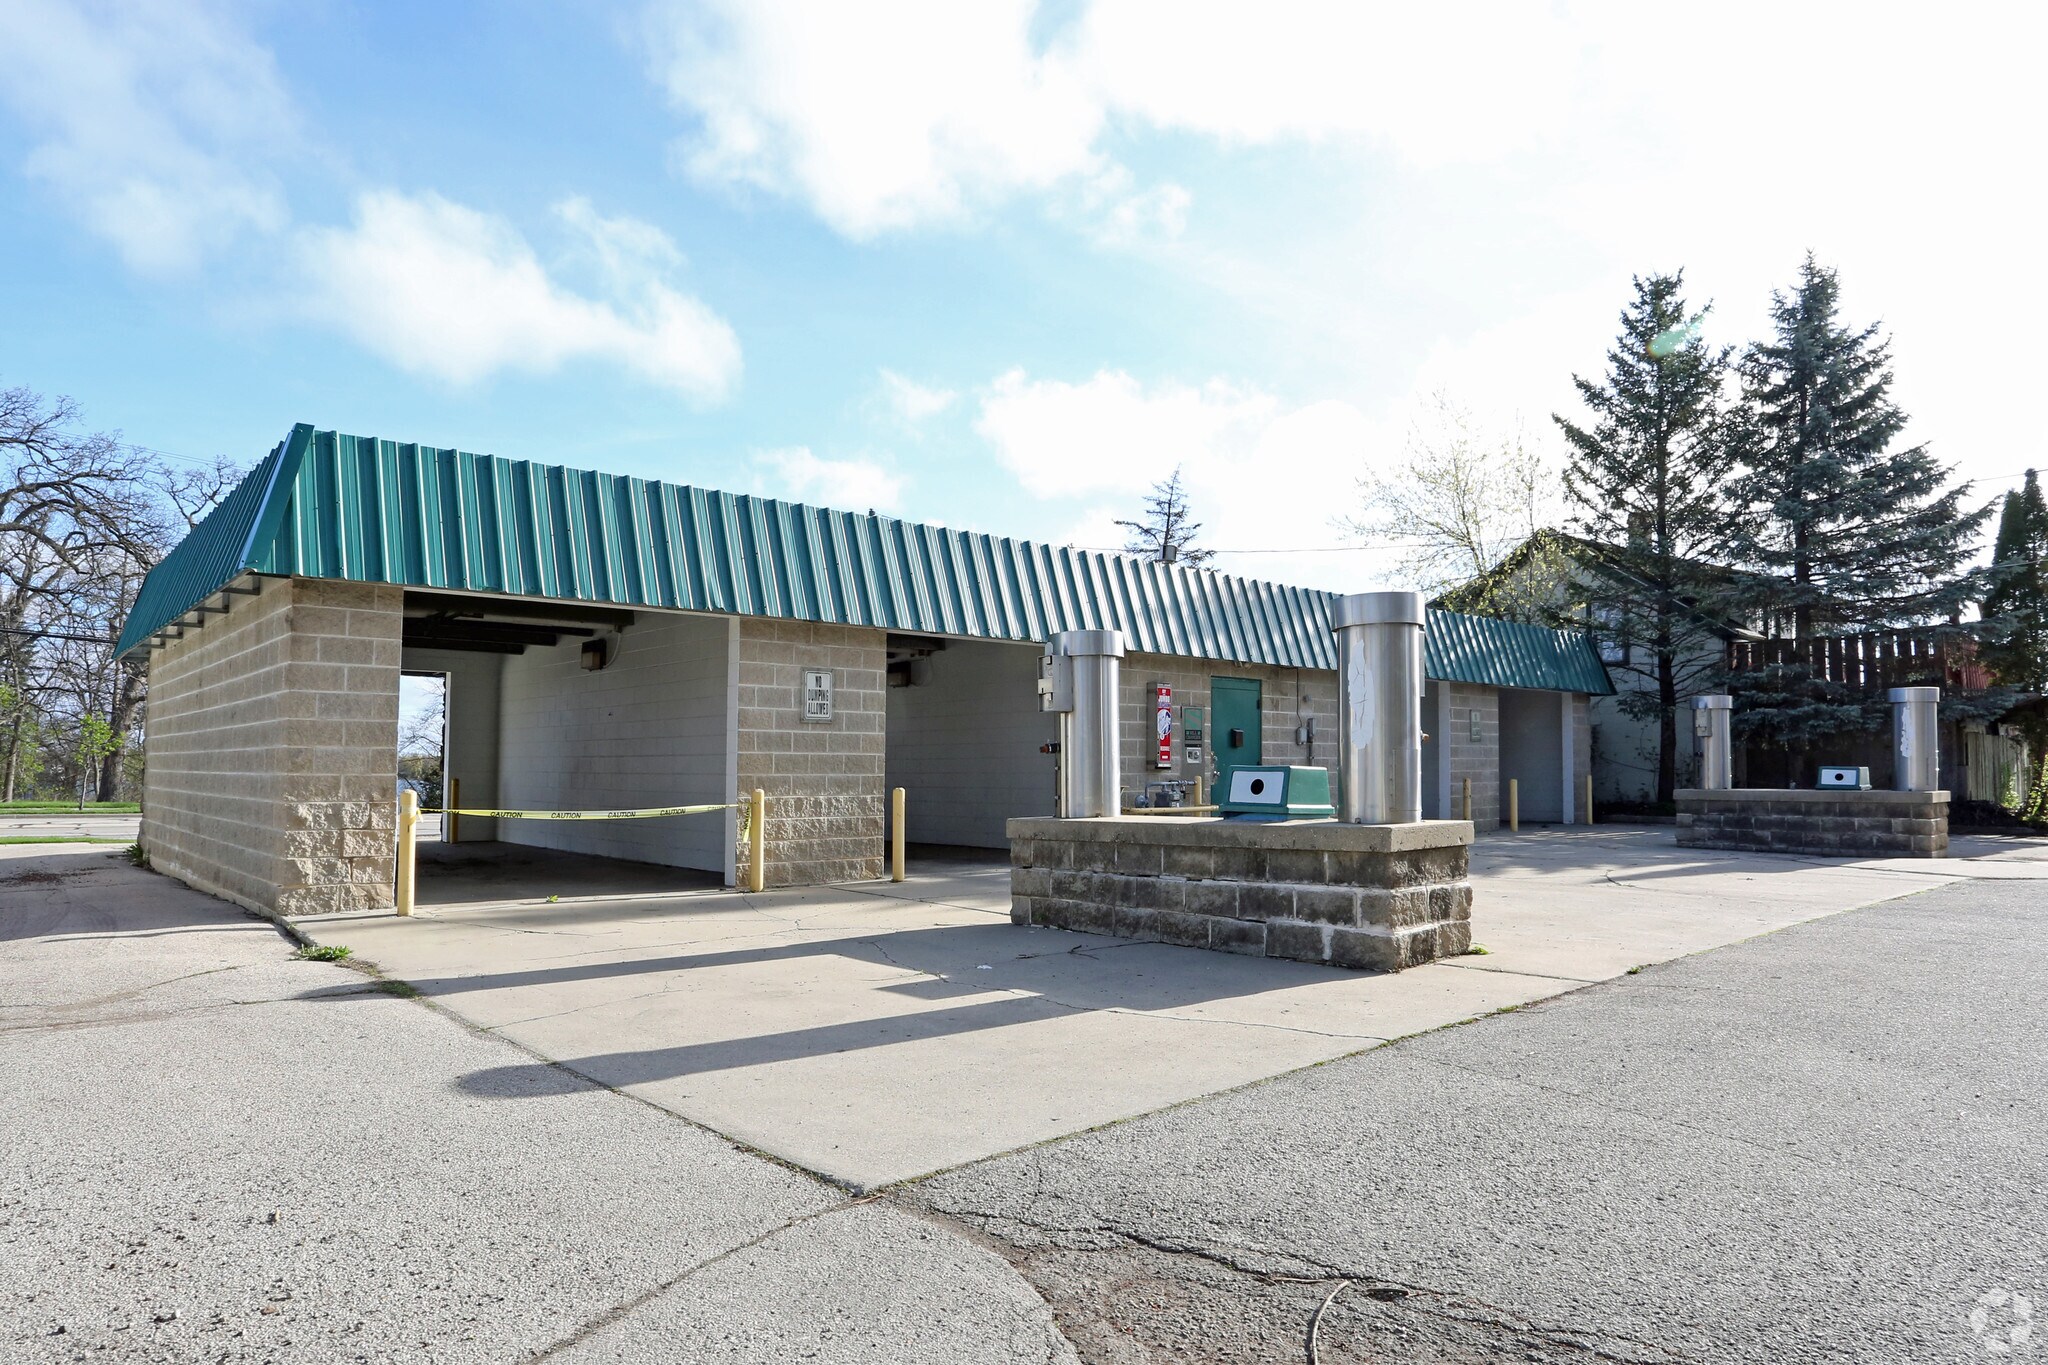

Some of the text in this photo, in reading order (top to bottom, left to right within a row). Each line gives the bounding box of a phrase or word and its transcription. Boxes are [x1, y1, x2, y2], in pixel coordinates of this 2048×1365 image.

[815, 675, 822, 688] NO
[808, 688, 829, 702] DUMPING
[808, 702, 829, 715] ALLOWED
[659, 808, 686, 816] CAUTION
